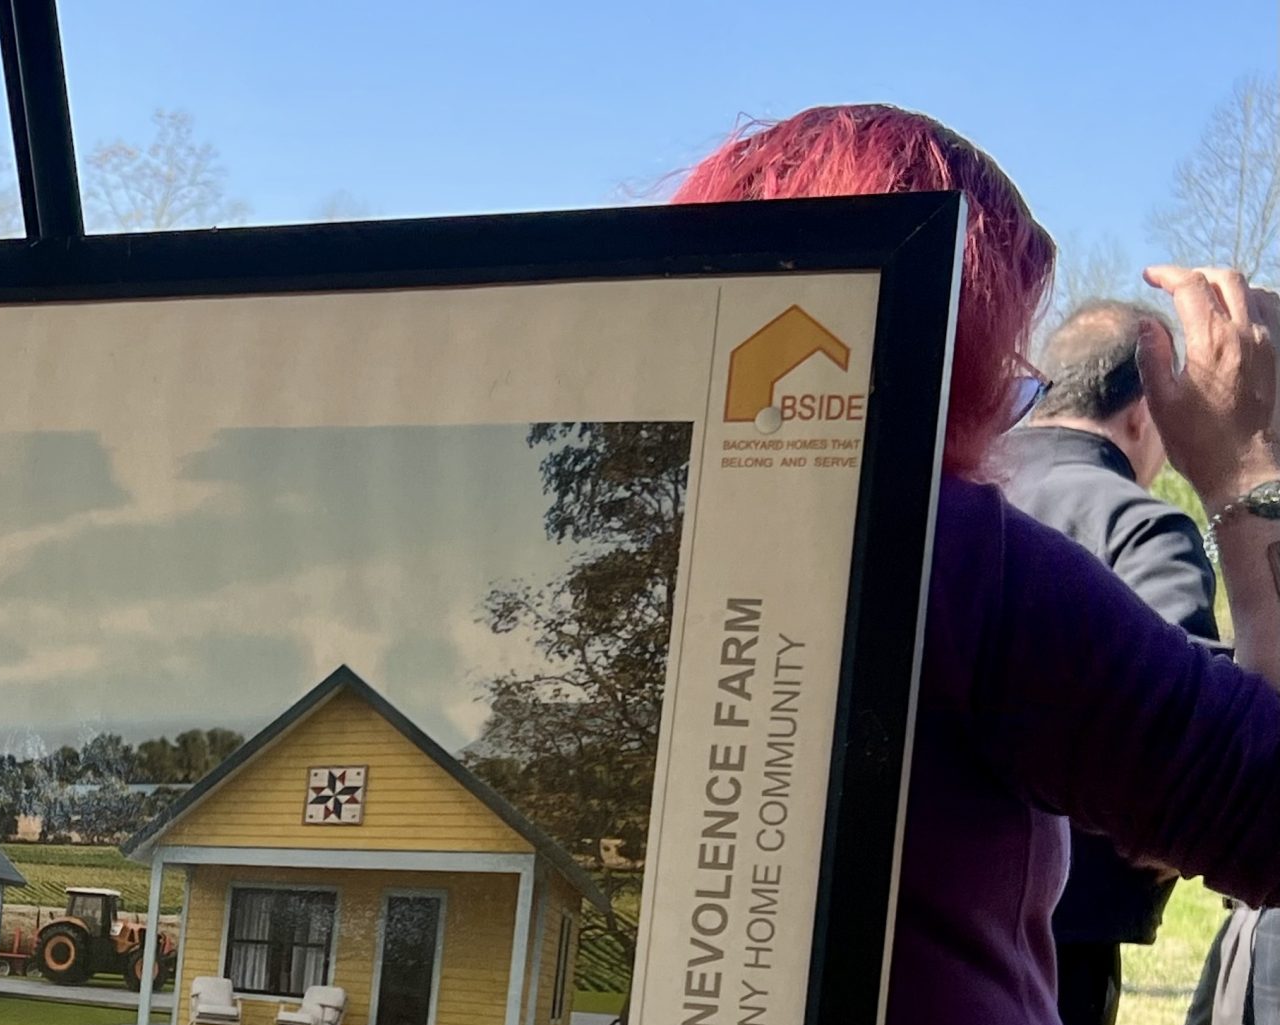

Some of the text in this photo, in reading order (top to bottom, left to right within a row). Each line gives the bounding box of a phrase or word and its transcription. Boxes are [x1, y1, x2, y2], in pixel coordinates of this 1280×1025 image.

[780, 394, 866, 422] BSIDE
[721, 457, 858, 469] BELONG AND SERVE
[722, 438, 862, 451] BACKYARD HOMES THAT
[713, 598, 763, 728] FARM
[756, 632, 806, 853] COMMUNITY
[743, 864, 782, 970] HOME
